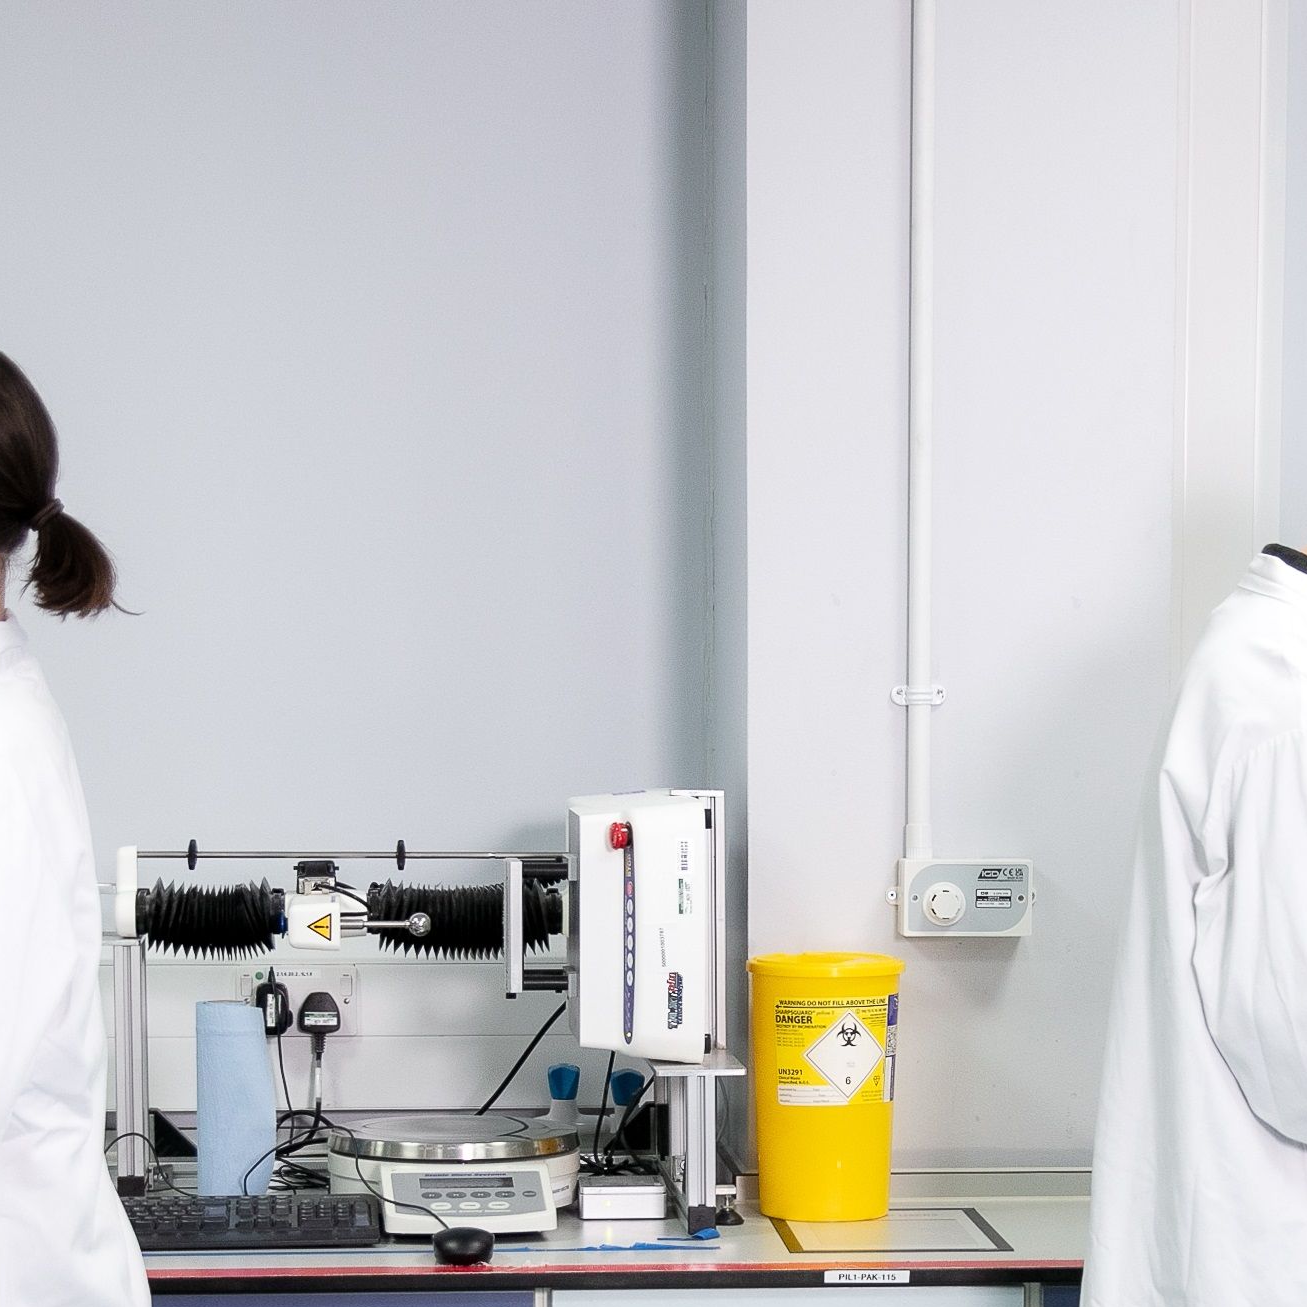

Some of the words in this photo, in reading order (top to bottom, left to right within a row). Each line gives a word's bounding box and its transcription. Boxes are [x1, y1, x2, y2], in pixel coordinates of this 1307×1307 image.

[775, 1015, 813, 1024] DANGER
[778, 1068, 803, 1076] UN3291
[845, 1076, 852, 1085] 6
[838, 1273, 897, 1281] PIL1-PAK-115
